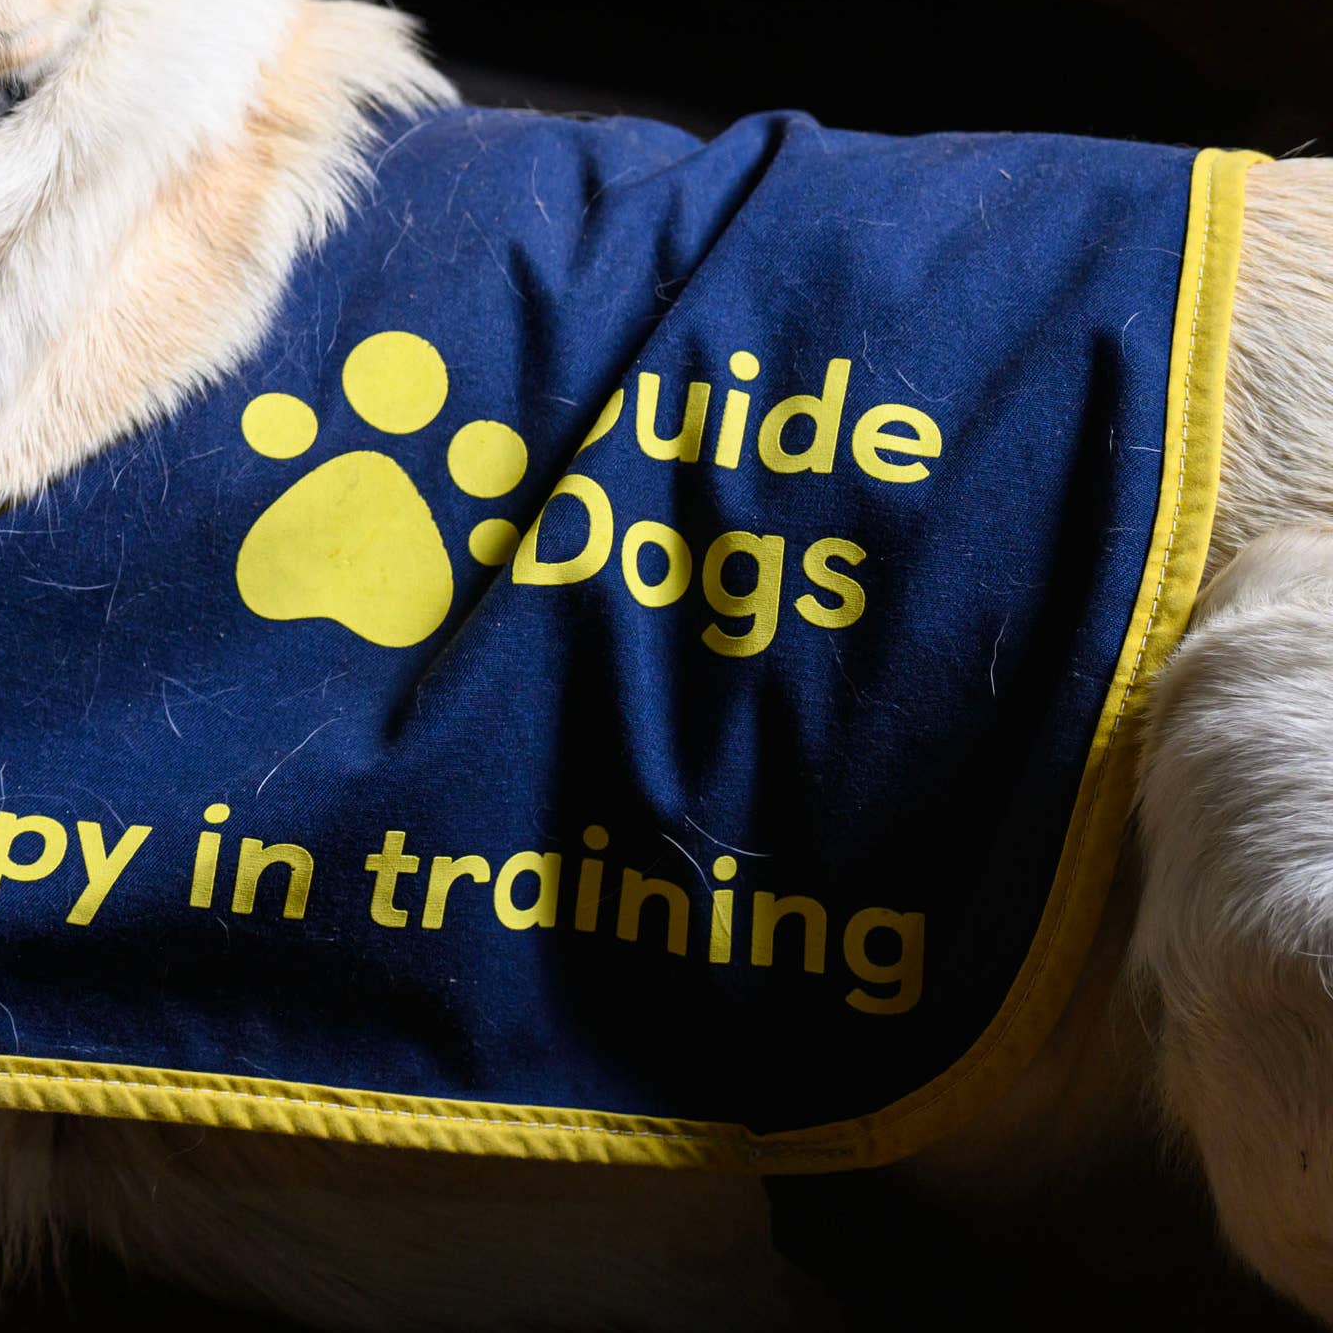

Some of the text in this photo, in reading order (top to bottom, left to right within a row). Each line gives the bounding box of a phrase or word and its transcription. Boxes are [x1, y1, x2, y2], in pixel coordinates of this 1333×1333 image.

[573, 352, 943, 484] uide
[511, 473, 867, 659] Dogs
[189, 803, 315, 920] in
[364, 825, 925, 1014] training
